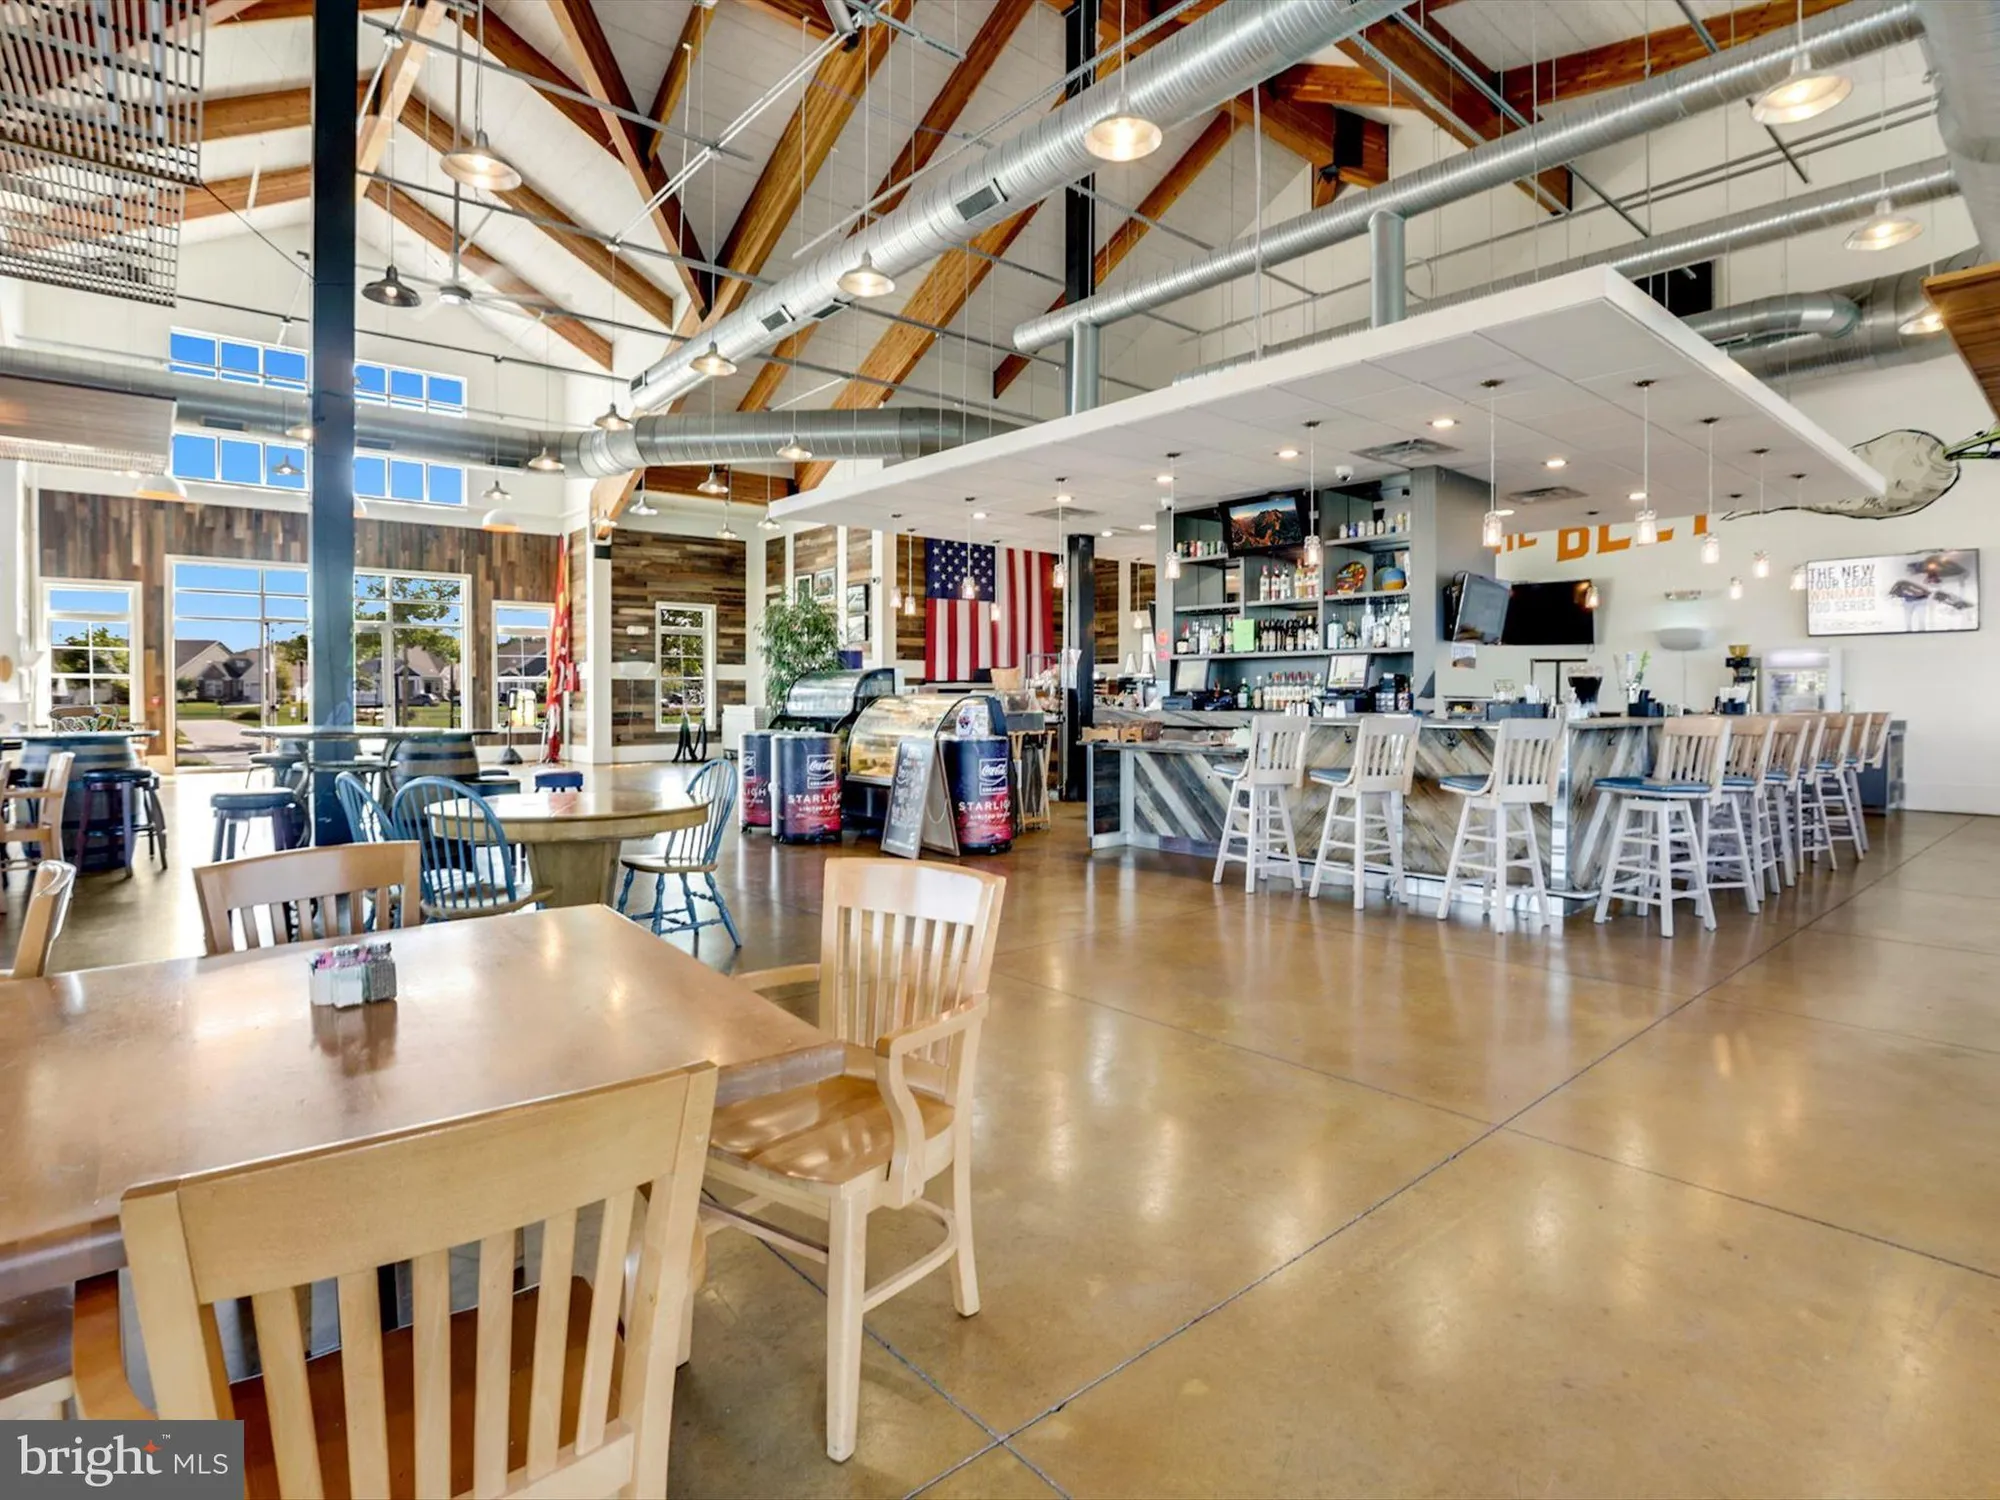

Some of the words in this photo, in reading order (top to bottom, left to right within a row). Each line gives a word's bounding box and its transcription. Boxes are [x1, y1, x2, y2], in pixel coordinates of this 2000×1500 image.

[1809, 566, 1835, 580] THE
[1842, 564, 1875, 579] NEW
[1809, 578, 1840, 591] TOUR
[1844, 577, 1875, 589] EDGE
[1810, 587, 1876, 601] WINGMAN
[1834, 599, 1876, 613] SERIES
